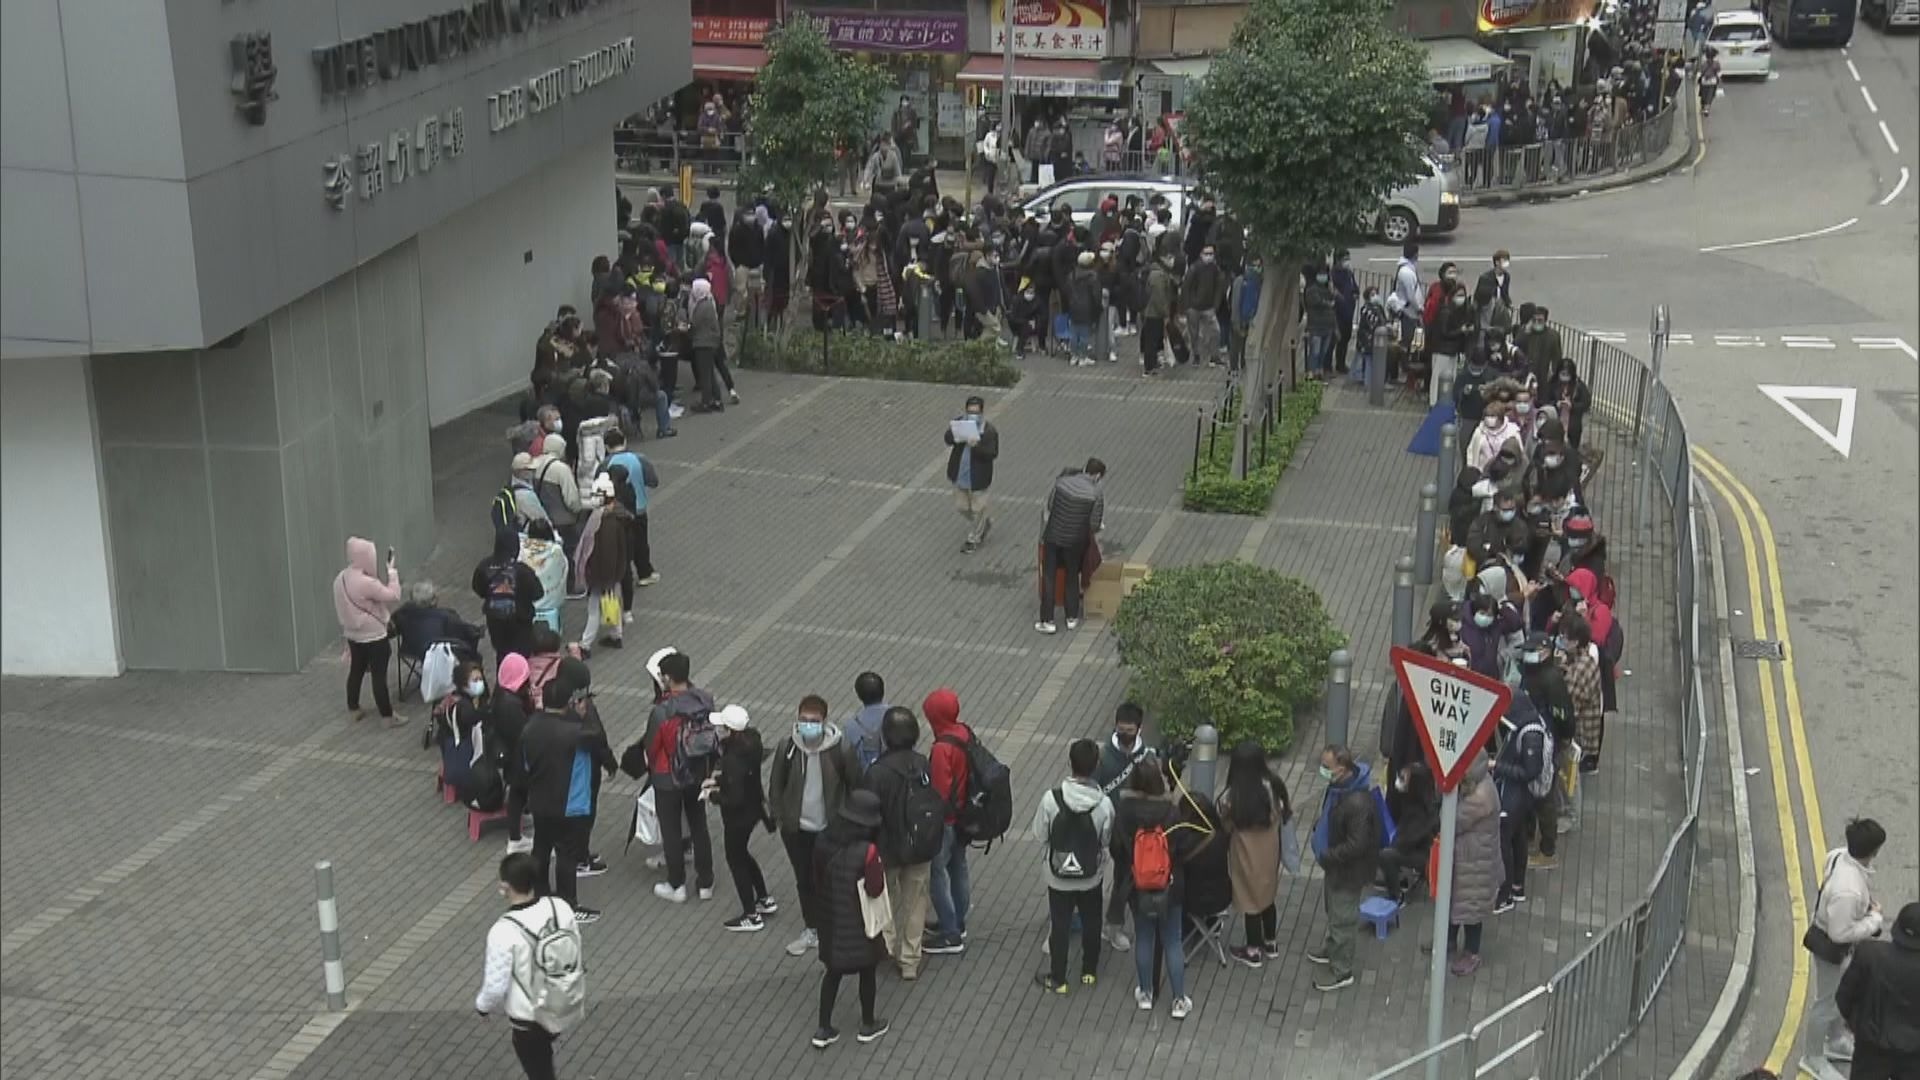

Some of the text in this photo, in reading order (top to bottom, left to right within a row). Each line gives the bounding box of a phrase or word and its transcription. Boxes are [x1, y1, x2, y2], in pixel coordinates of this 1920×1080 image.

[487, 86, 525, 132] LEE
[570, 37, 635, 94] BUILDING
[1430, 678, 1471, 705] GIVE
[1431, 698, 1469, 724] WAY
[1439, 727, 1456, 752] 讓
